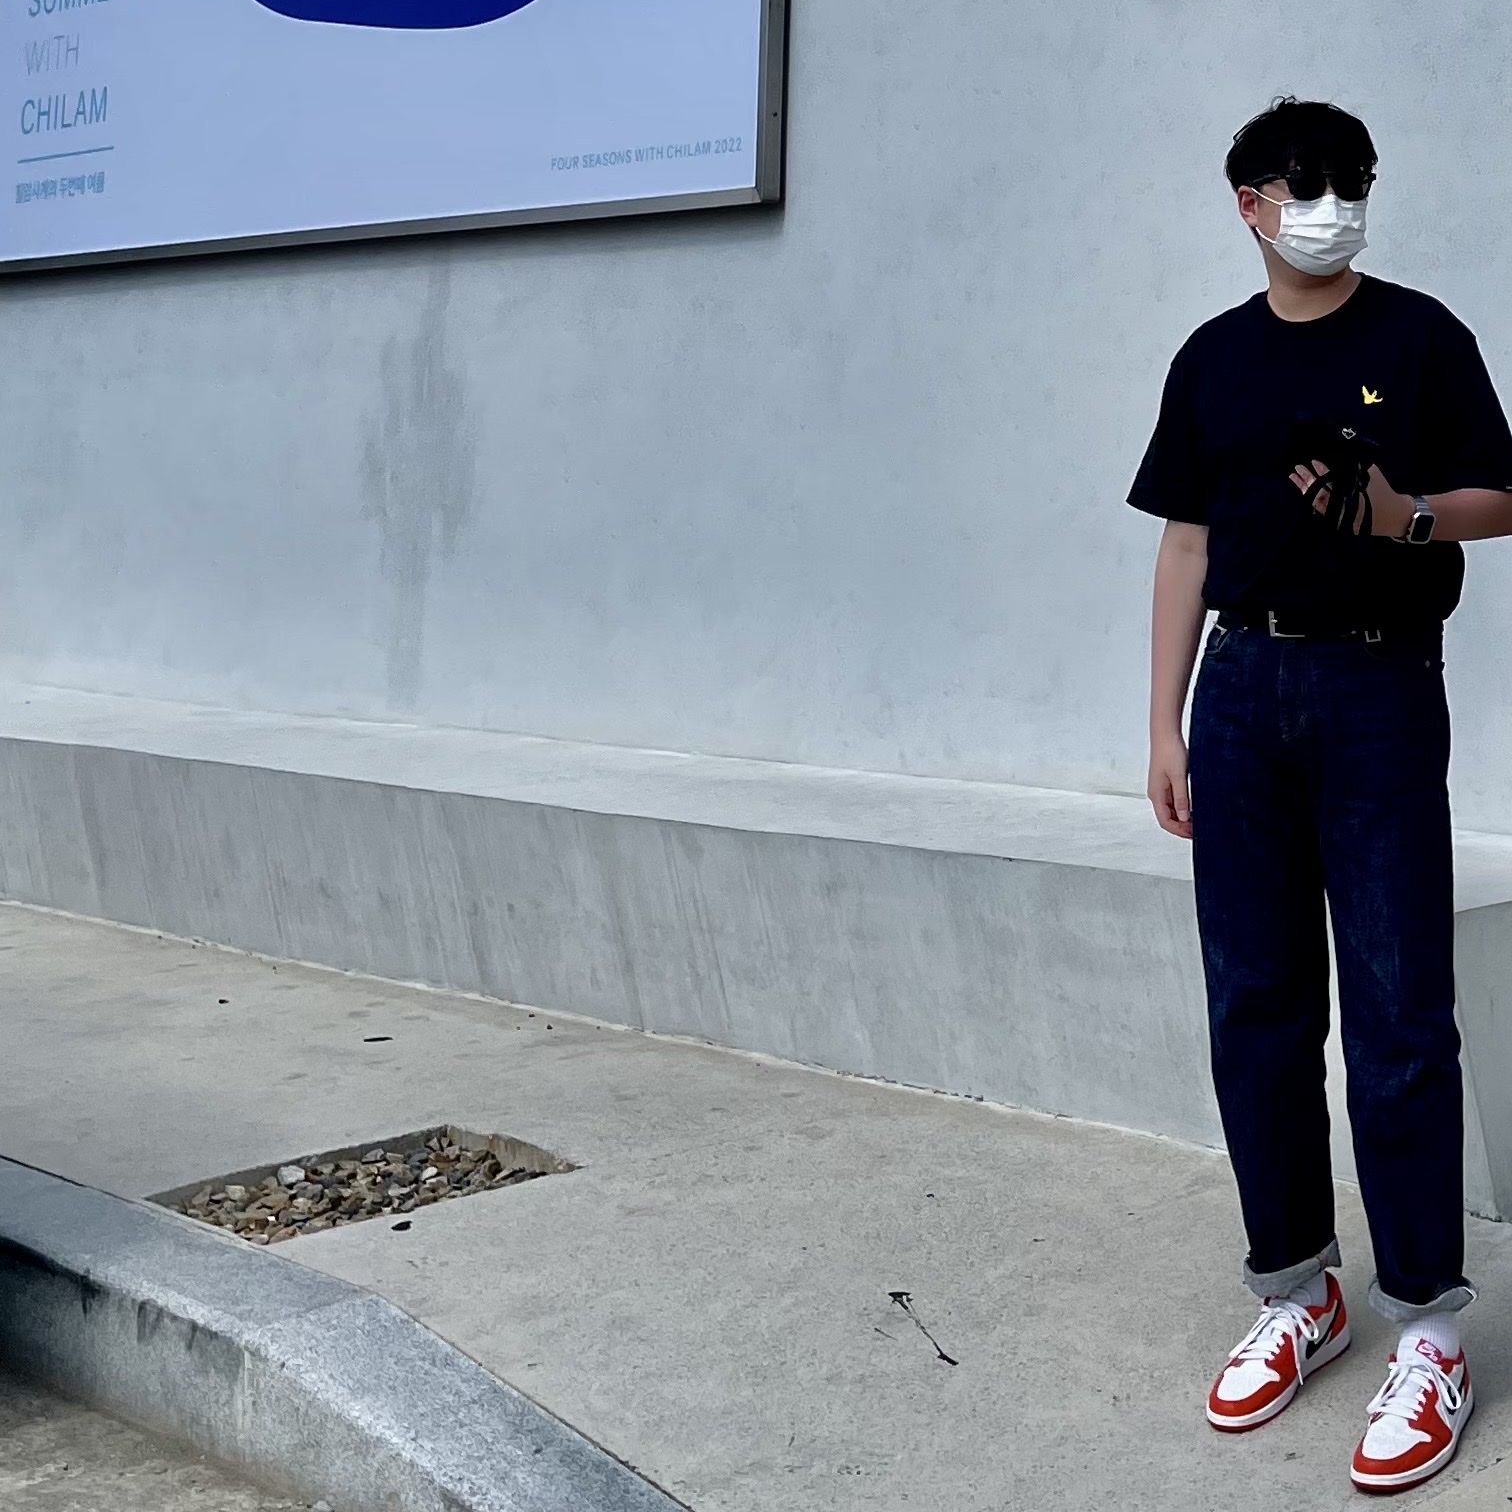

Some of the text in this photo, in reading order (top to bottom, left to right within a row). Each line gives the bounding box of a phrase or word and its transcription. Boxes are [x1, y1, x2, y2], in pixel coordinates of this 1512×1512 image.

[25, 34, 79, 76] WITH
[20, 86, 108, 135] CHILAM
[551, 137, 742, 171] FOUR SEASONS WITH CHILAM 2022
